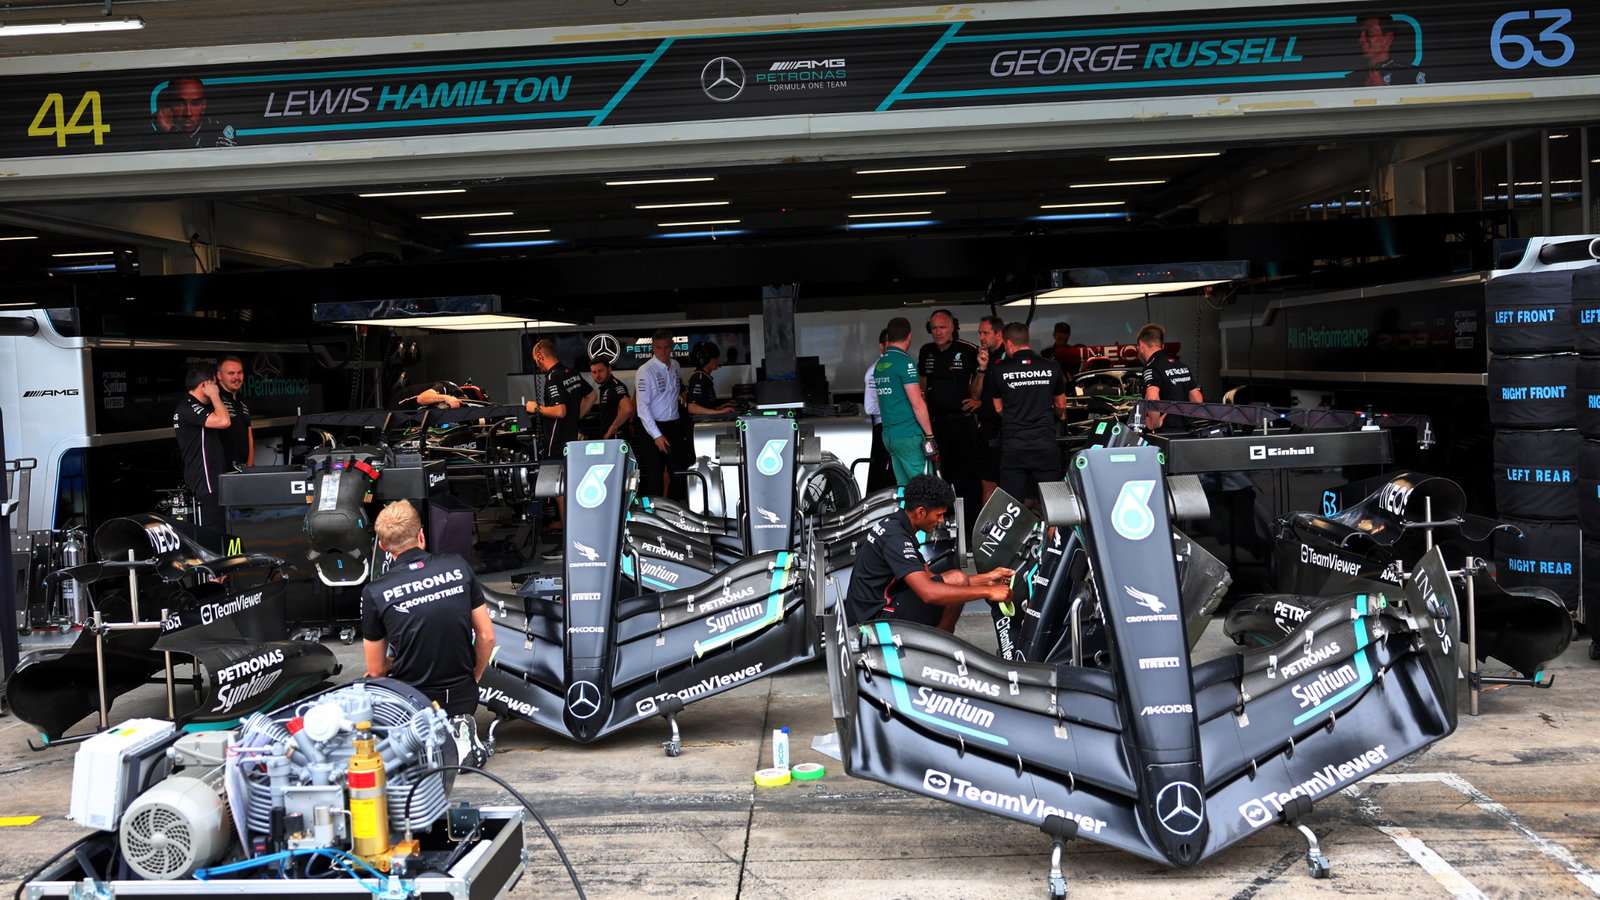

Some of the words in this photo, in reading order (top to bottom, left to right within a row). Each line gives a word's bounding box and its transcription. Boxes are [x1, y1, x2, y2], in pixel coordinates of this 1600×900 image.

[1490, 8, 1575, 70] 63
[794, 58, 846, 70] AMG
[989, 43, 1141, 78] GEORGE
[1142, 36, 1304, 70] RUSSELL
[756, 69, 847, 83] PETRONAS
[769, 83, 806, 92] FORMULA
[808, 81, 824, 89] ONE
[827, 80, 847, 88] TEAM
[264, 85, 374, 119] LEWIS
[376, 76, 573, 112] HAMILTON
[27, 91, 111, 148] 44
[1495, 311, 1514, 323] LEFT
[1517, 309, 1556, 323] FRONT
[626, 343, 689, 352] PETRAS
[1287, 327, 1298, 349] All
[1307, 326, 1369, 348] Performance
[247, 373, 310, 397] Performance
[1002, 369, 1052, 381] PETRONAS
[1011, 379, 1050, 388] CROWDSTRIKE
[42, 388, 79, 396] AMG
[1502, 387, 1528, 400] RIGHT
[1530, 385, 1567, 399] FRONT
[1267, 446, 1315, 457] Einhell
[1507, 468, 1530, 481] LEFT
[1536, 469, 1571, 483] REAR
[1322, 490, 1338, 518] 63
[979, 502, 1021, 557] INEOS
[641, 542, 685, 561] PETRONAS
[1308, 547, 1362, 577] TeamViewer
[639, 558, 679, 584] Syntium
[1509, 557, 1536, 573] RIGHT
[1540, 561, 1573, 575] REAR
[383, 568, 464, 603] PETRONAS
[398, 585, 465, 609] CROWDSTRIKE
[212, 592, 264, 620] TeamViewer
[699, 586, 756, 613] PETRONAS
[566, 626, 605, 634] AKKODIS
[705, 603, 764, 634] Syntium
[1125, 614, 1178, 623] CROWDSTRIKE
[217, 648, 285, 685] PETRONAS
[1280, 641, 1341, 680] PETRONAS
[211, 668, 283, 714] Syntium
[921, 666, 1001, 697] PETRONAS
[1291, 664, 1358, 708] Syntium
[912, 686, 995, 729] Syntium
[1140, 704, 1194, 716] AKKODIS
[1262, 743, 1390, 813] TeamViewer
